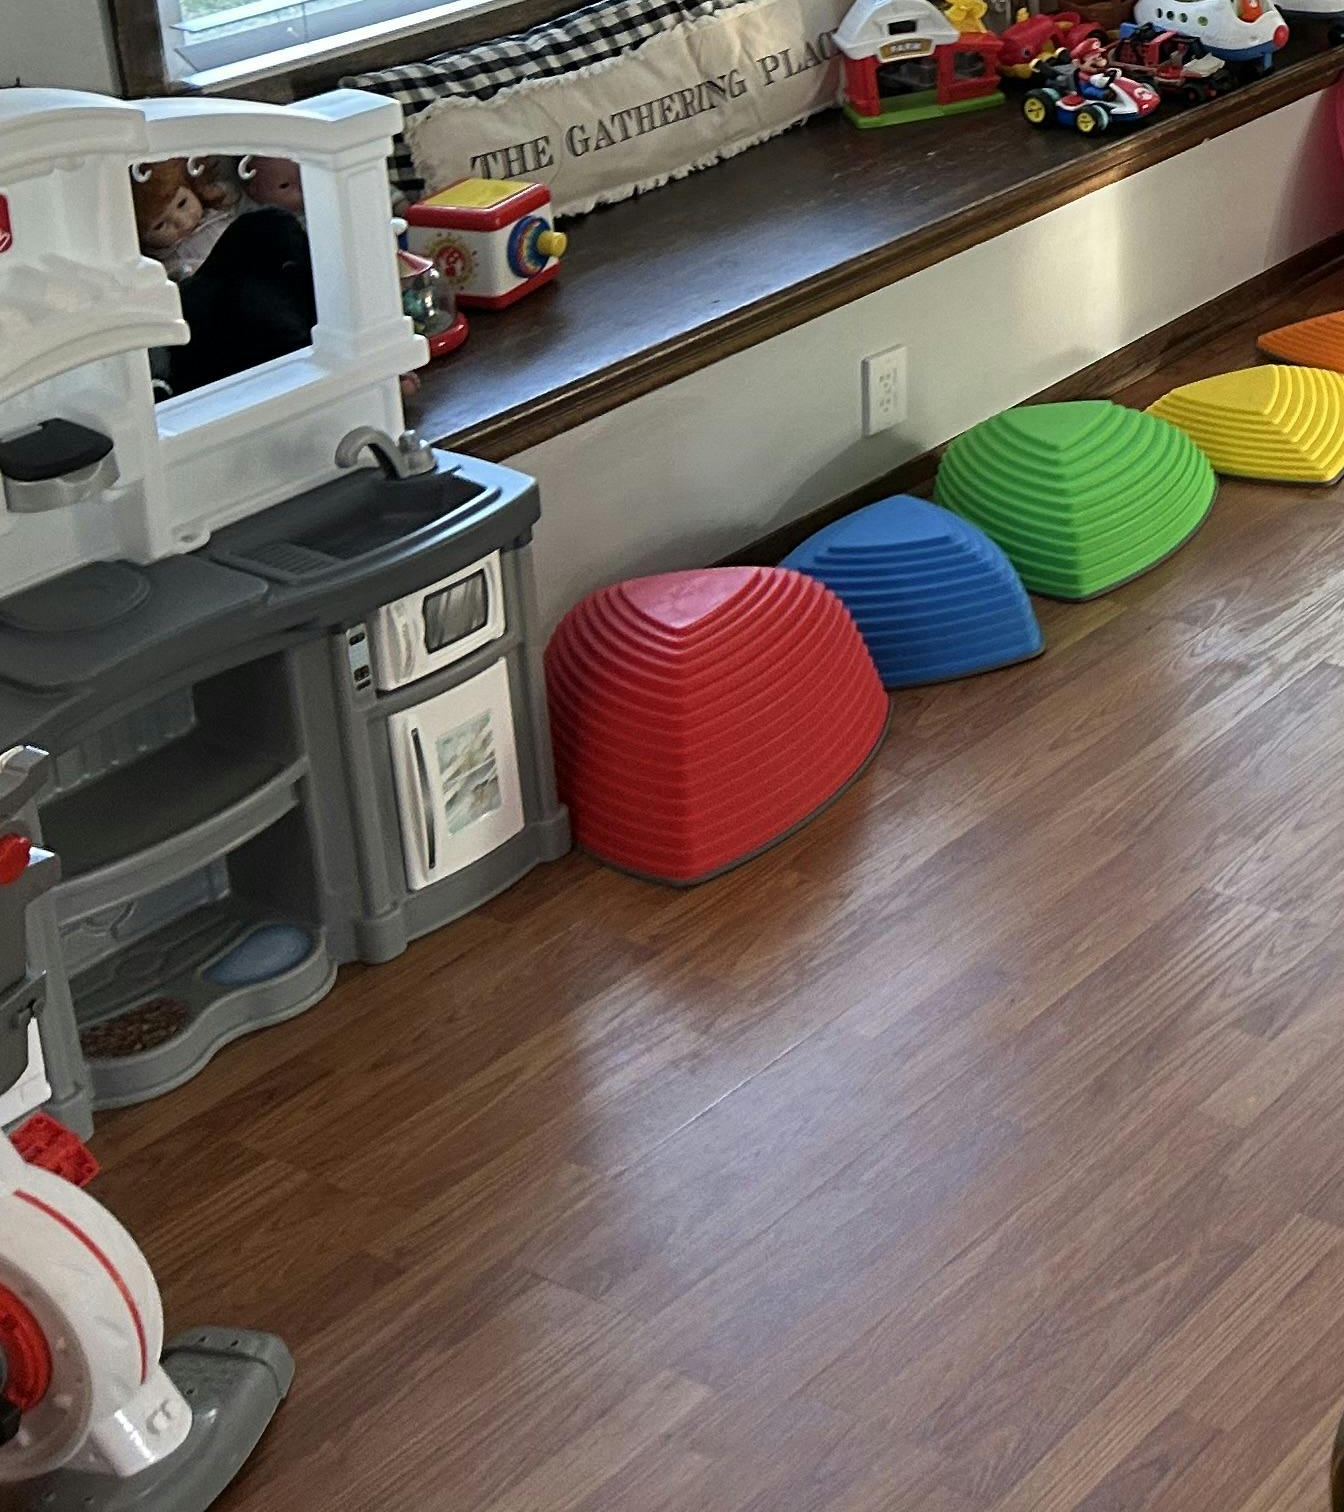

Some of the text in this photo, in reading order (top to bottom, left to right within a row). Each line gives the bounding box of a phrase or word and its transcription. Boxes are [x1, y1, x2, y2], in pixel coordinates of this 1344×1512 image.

[470, 27, 842, 180] THE GATHERING PLAC
